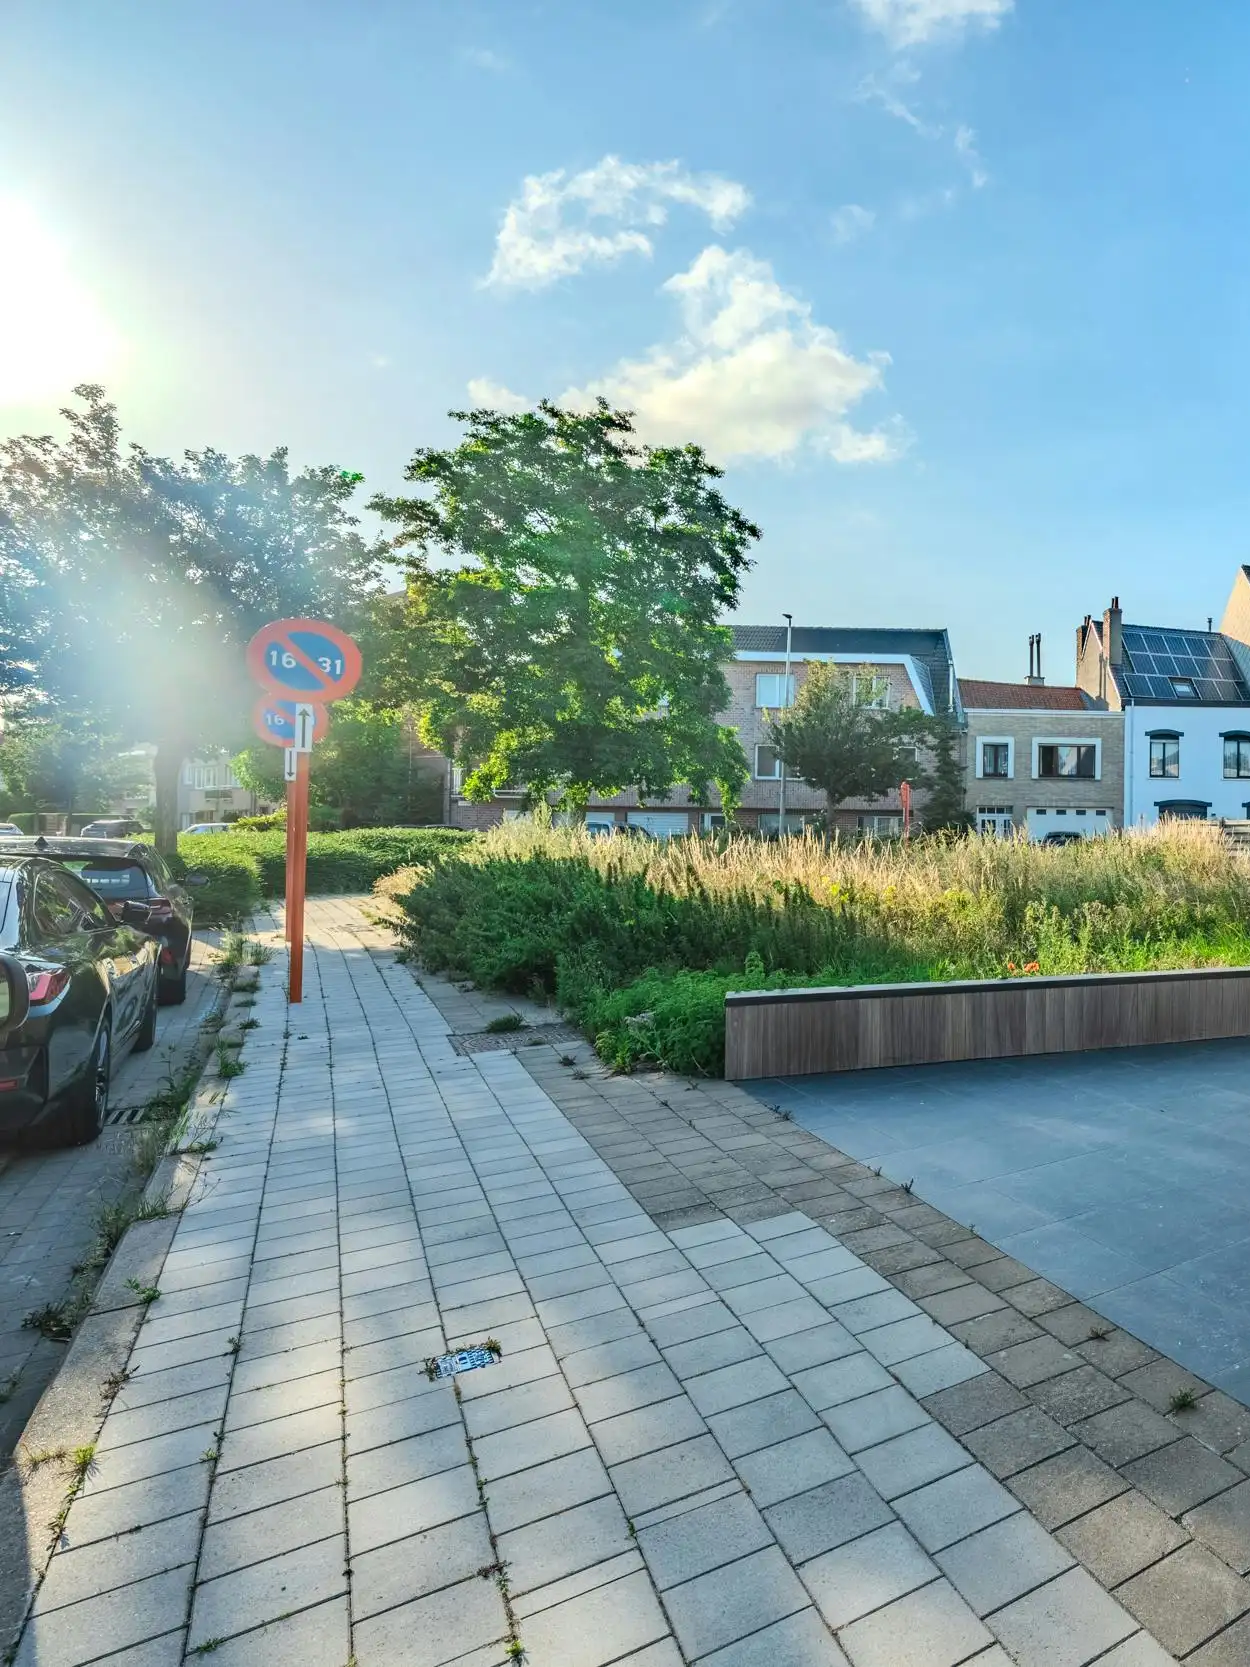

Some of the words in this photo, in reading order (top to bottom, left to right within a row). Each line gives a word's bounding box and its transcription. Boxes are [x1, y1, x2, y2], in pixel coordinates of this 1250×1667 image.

[269, 650, 297, 669] 16
[318, 656, 342, 675] 31
[265, 714, 285, 726] 16
